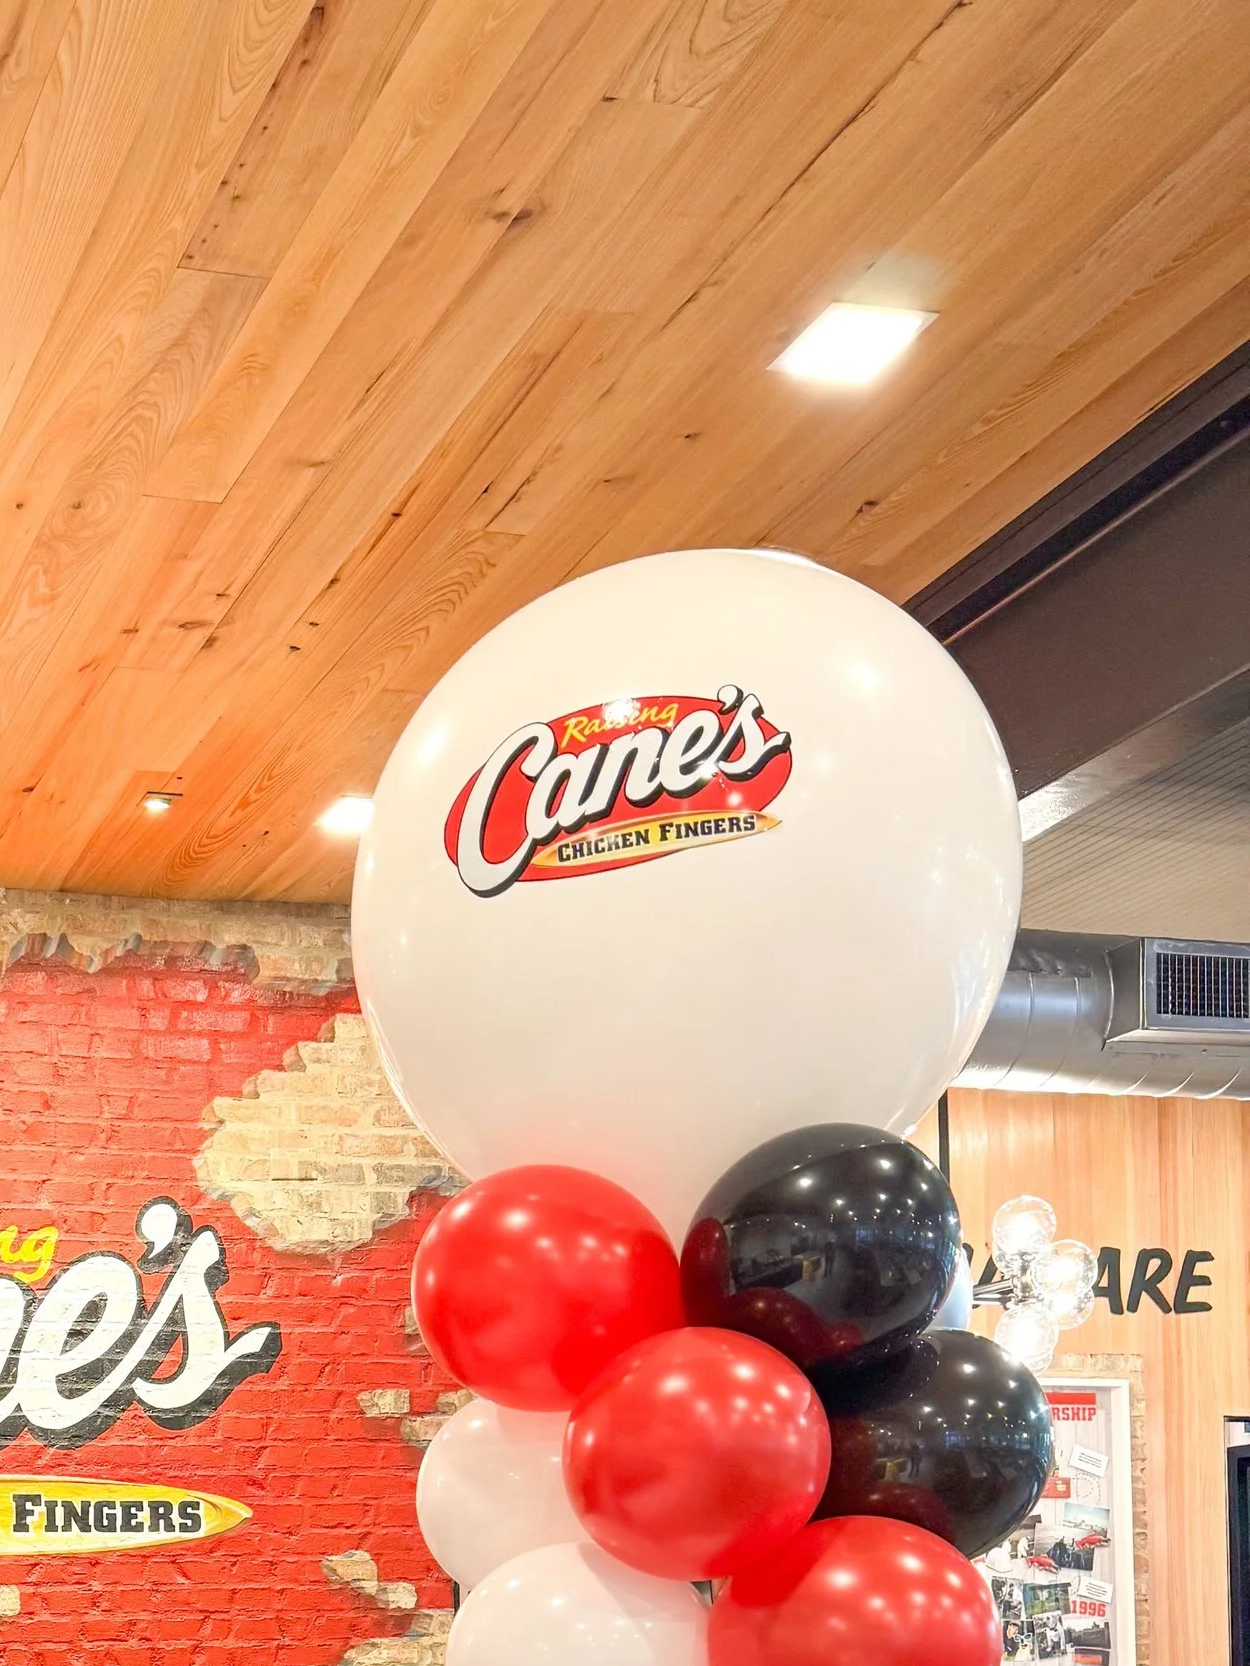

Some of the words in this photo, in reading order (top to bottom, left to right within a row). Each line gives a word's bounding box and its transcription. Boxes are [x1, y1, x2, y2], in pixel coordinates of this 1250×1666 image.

[457, 684, 792, 898] Cane's
[558, 829, 650, 863] CHICKEN
[659, 814, 756, 842] FINGERS
[1050, 1246, 1215, 1316] ARE
[1051, 1406, 1097, 1421] RSHIP
[13, 1492, 202, 1534] FINGERS
[1070, 1599, 1108, 1618] 1996
